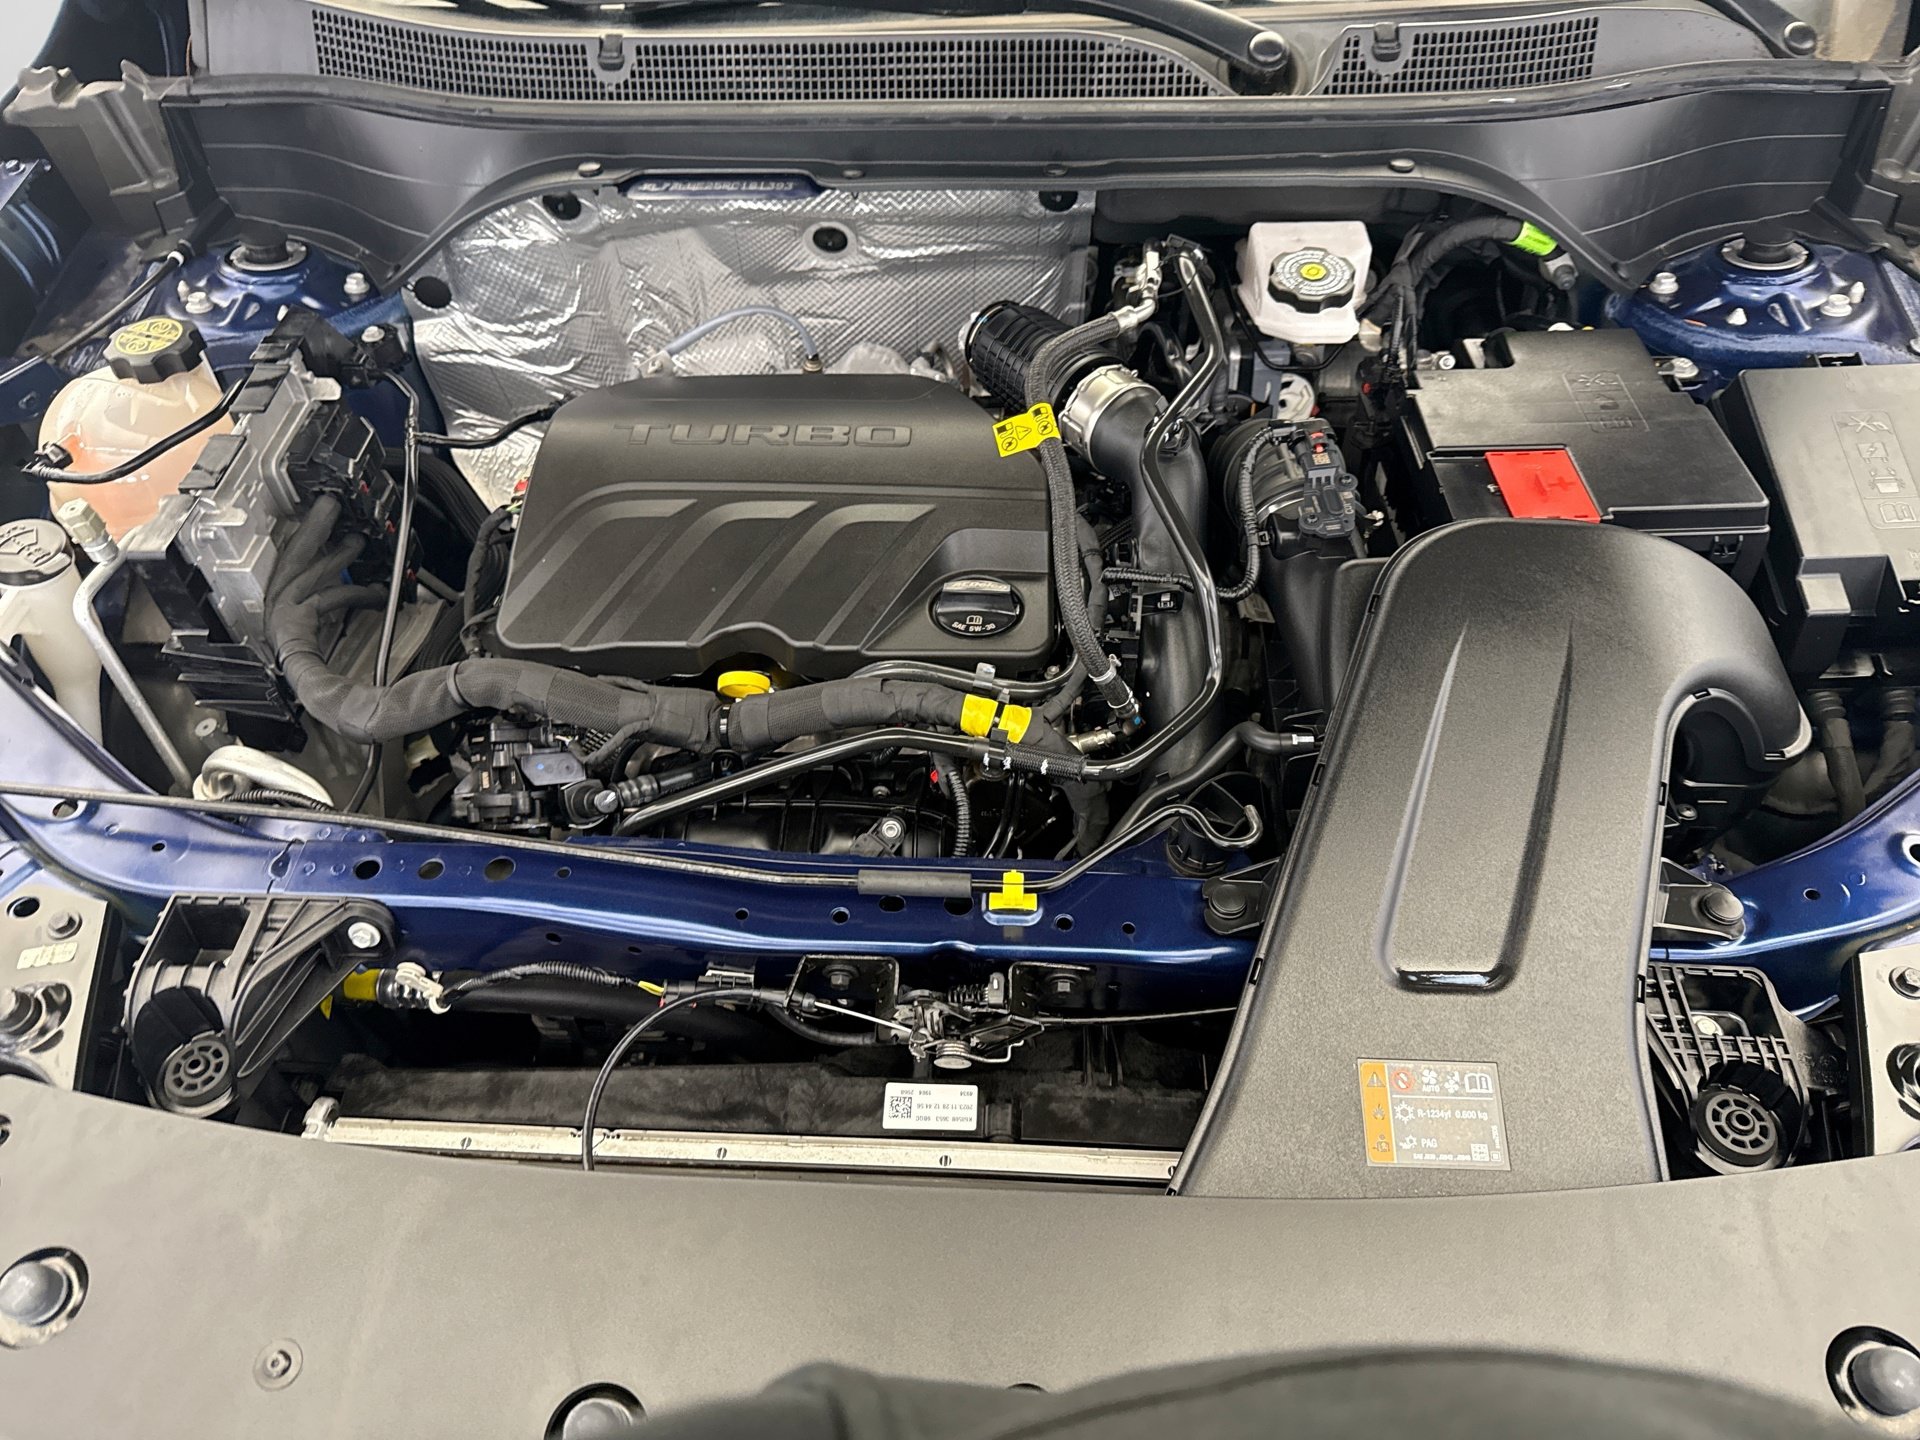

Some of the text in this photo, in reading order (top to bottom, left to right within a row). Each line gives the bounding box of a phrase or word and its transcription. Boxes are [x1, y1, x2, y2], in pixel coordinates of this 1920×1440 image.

[613, 423, 913, 448] TURBO
[952, 622, 996, 631] SAE 5W-30
[1422, 1085, 1440, 1093] AUTO
[1478, 1110, 1488, 1120] kg
[1421, 1138, 1438, 1148] PAG
